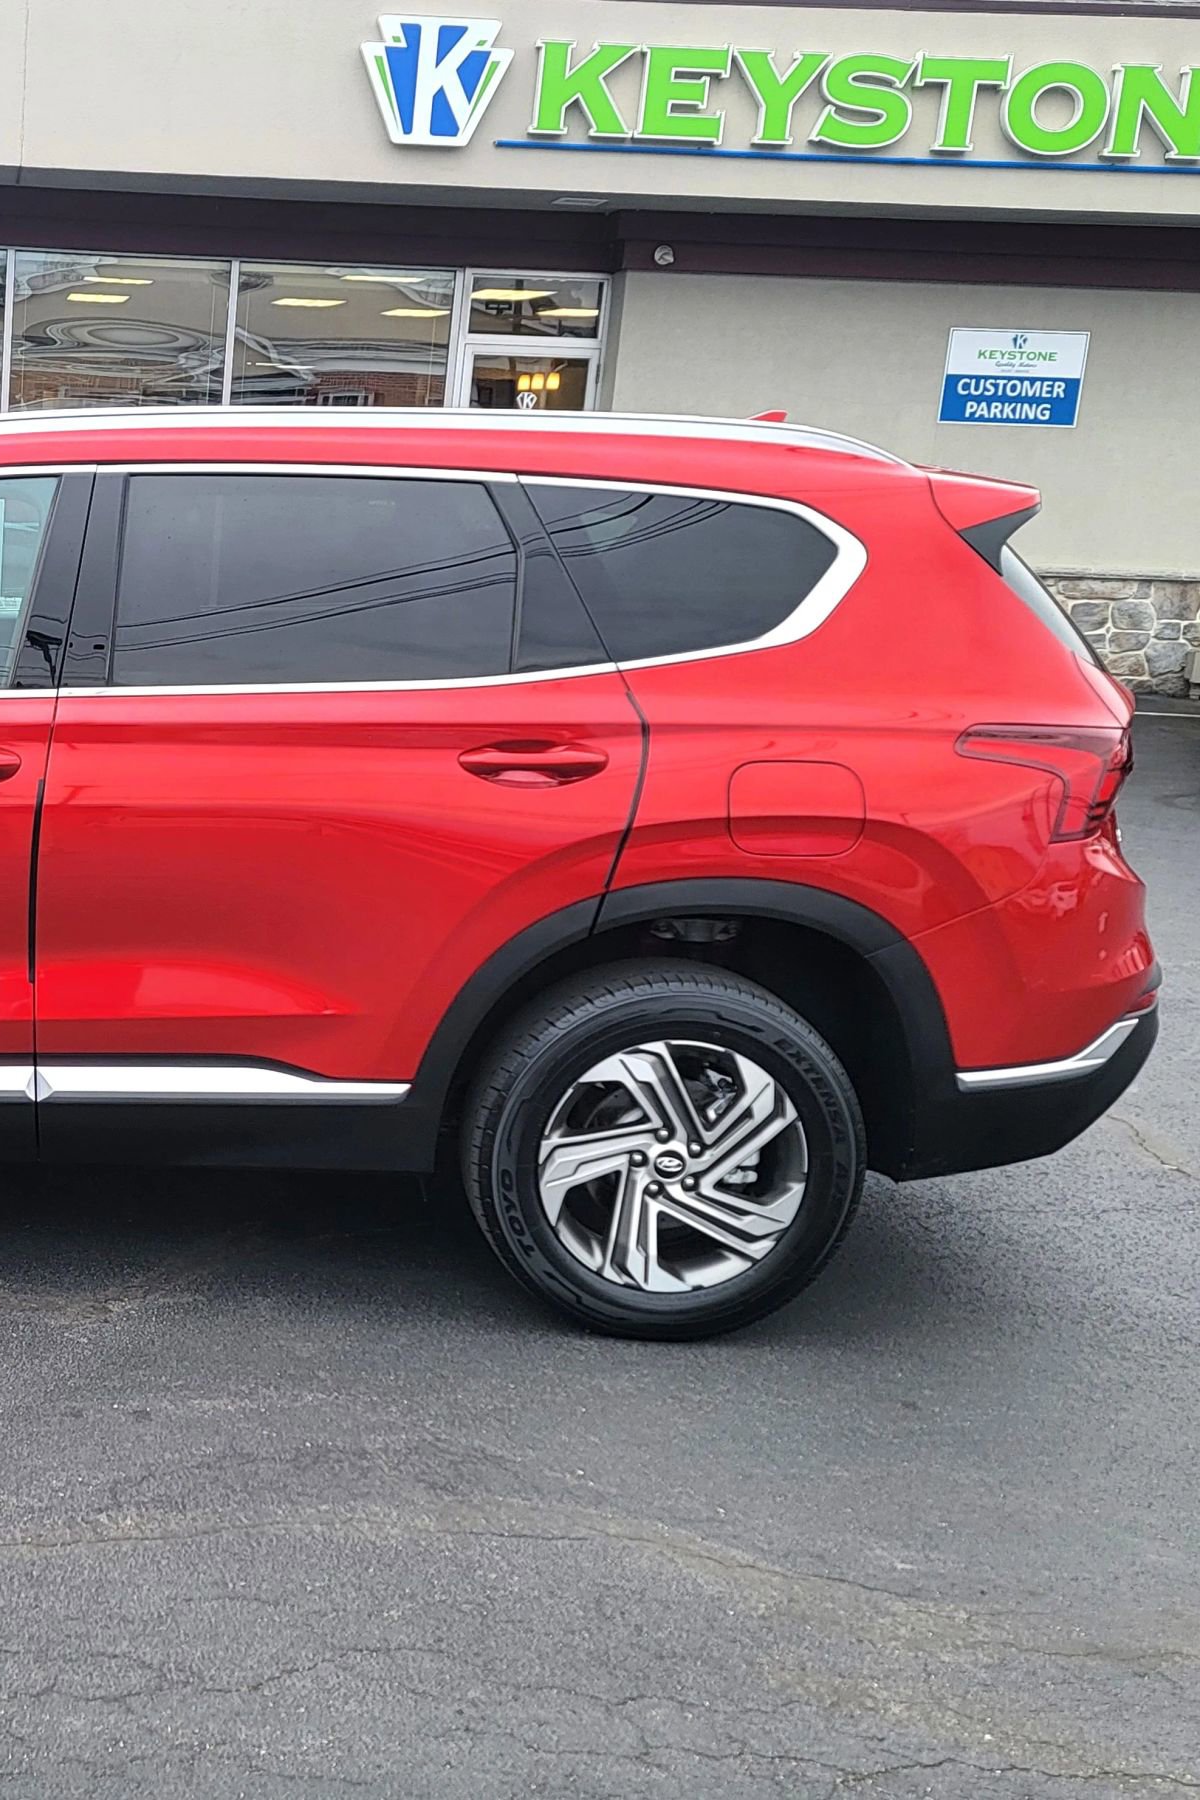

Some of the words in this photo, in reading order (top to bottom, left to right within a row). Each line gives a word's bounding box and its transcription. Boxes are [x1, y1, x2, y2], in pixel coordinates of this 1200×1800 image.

[527, 38, 1200, 159] KEYSTON
[977, 349, 1058, 362] KEYSTONE
[957, 378, 1066, 398] CUSTOMER
[964, 401, 1051, 420] PARKING
[501, 1169, 535, 1258] TOYO
